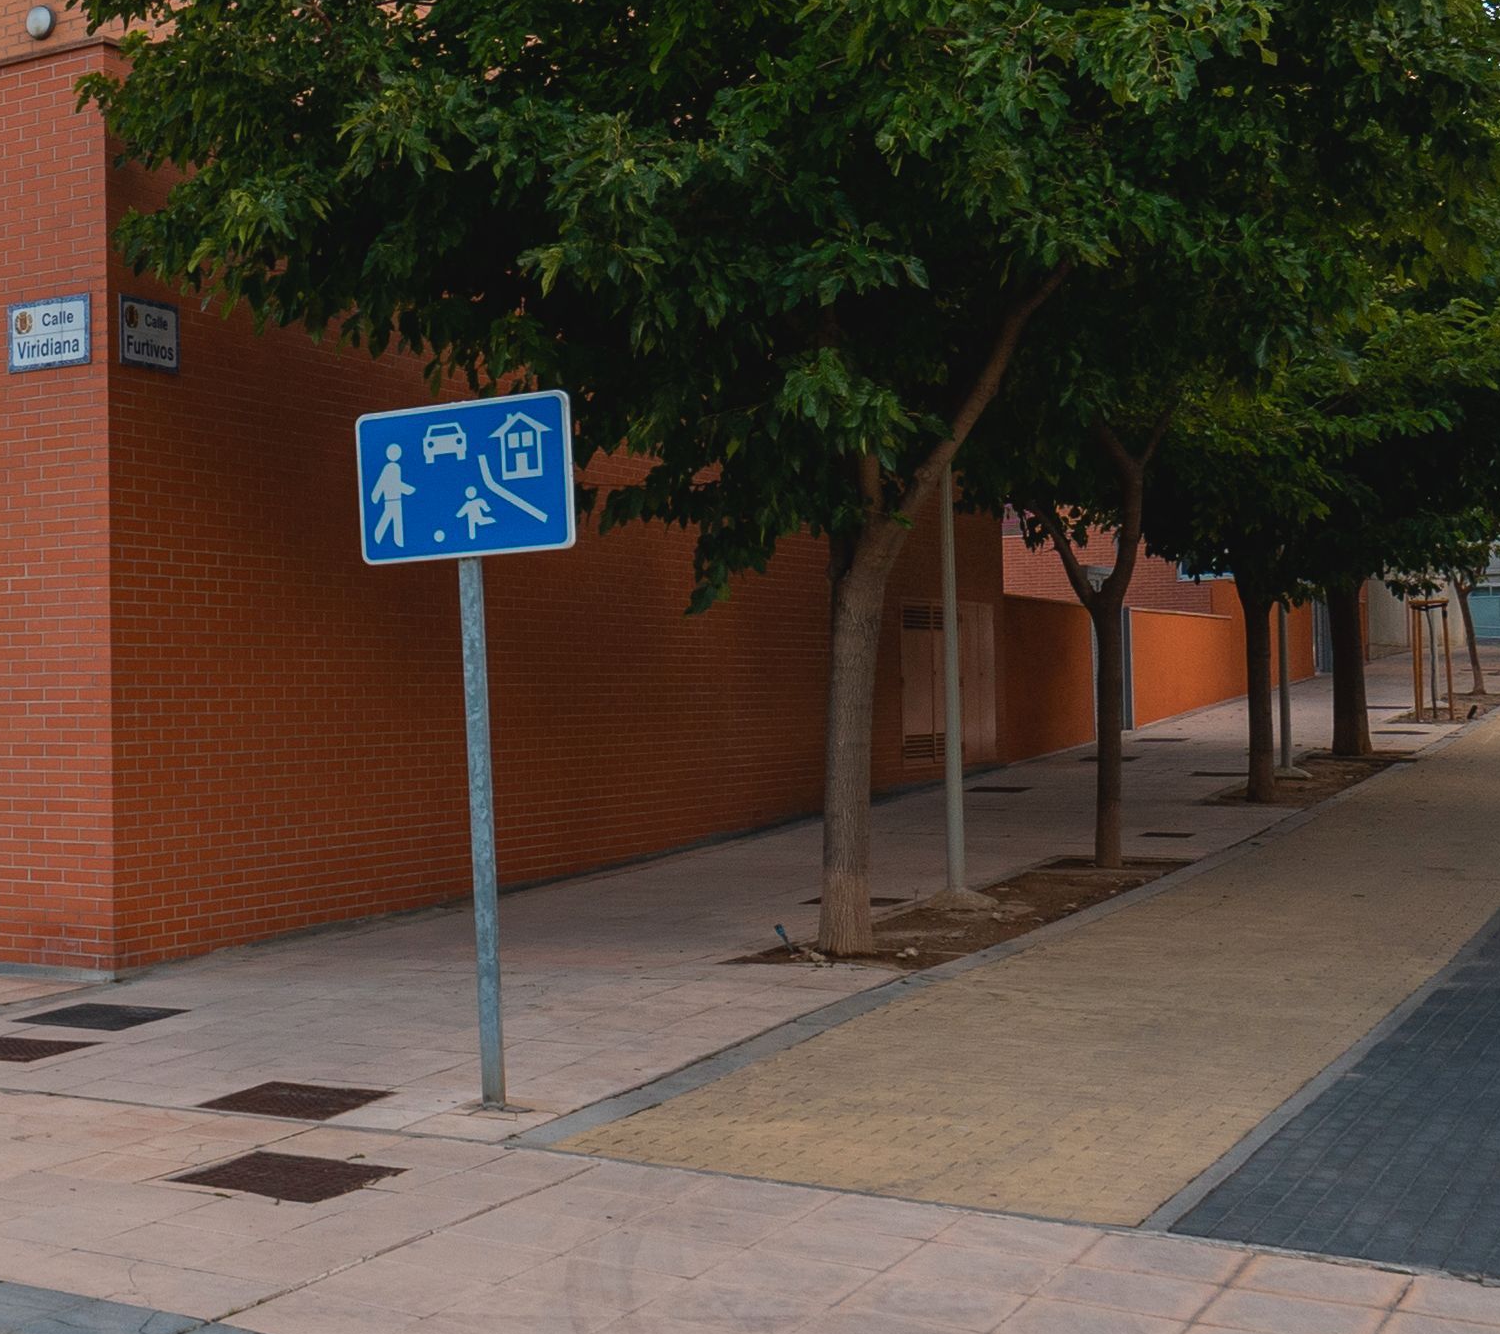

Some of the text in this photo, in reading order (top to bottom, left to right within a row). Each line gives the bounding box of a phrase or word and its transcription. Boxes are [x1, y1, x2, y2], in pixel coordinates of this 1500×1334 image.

[42, 311, 74, 327] Calle
[144, 313, 169, 331] Calle
[17, 337, 80, 360] Viridiana
[126, 335, 174, 361] Furtivos
